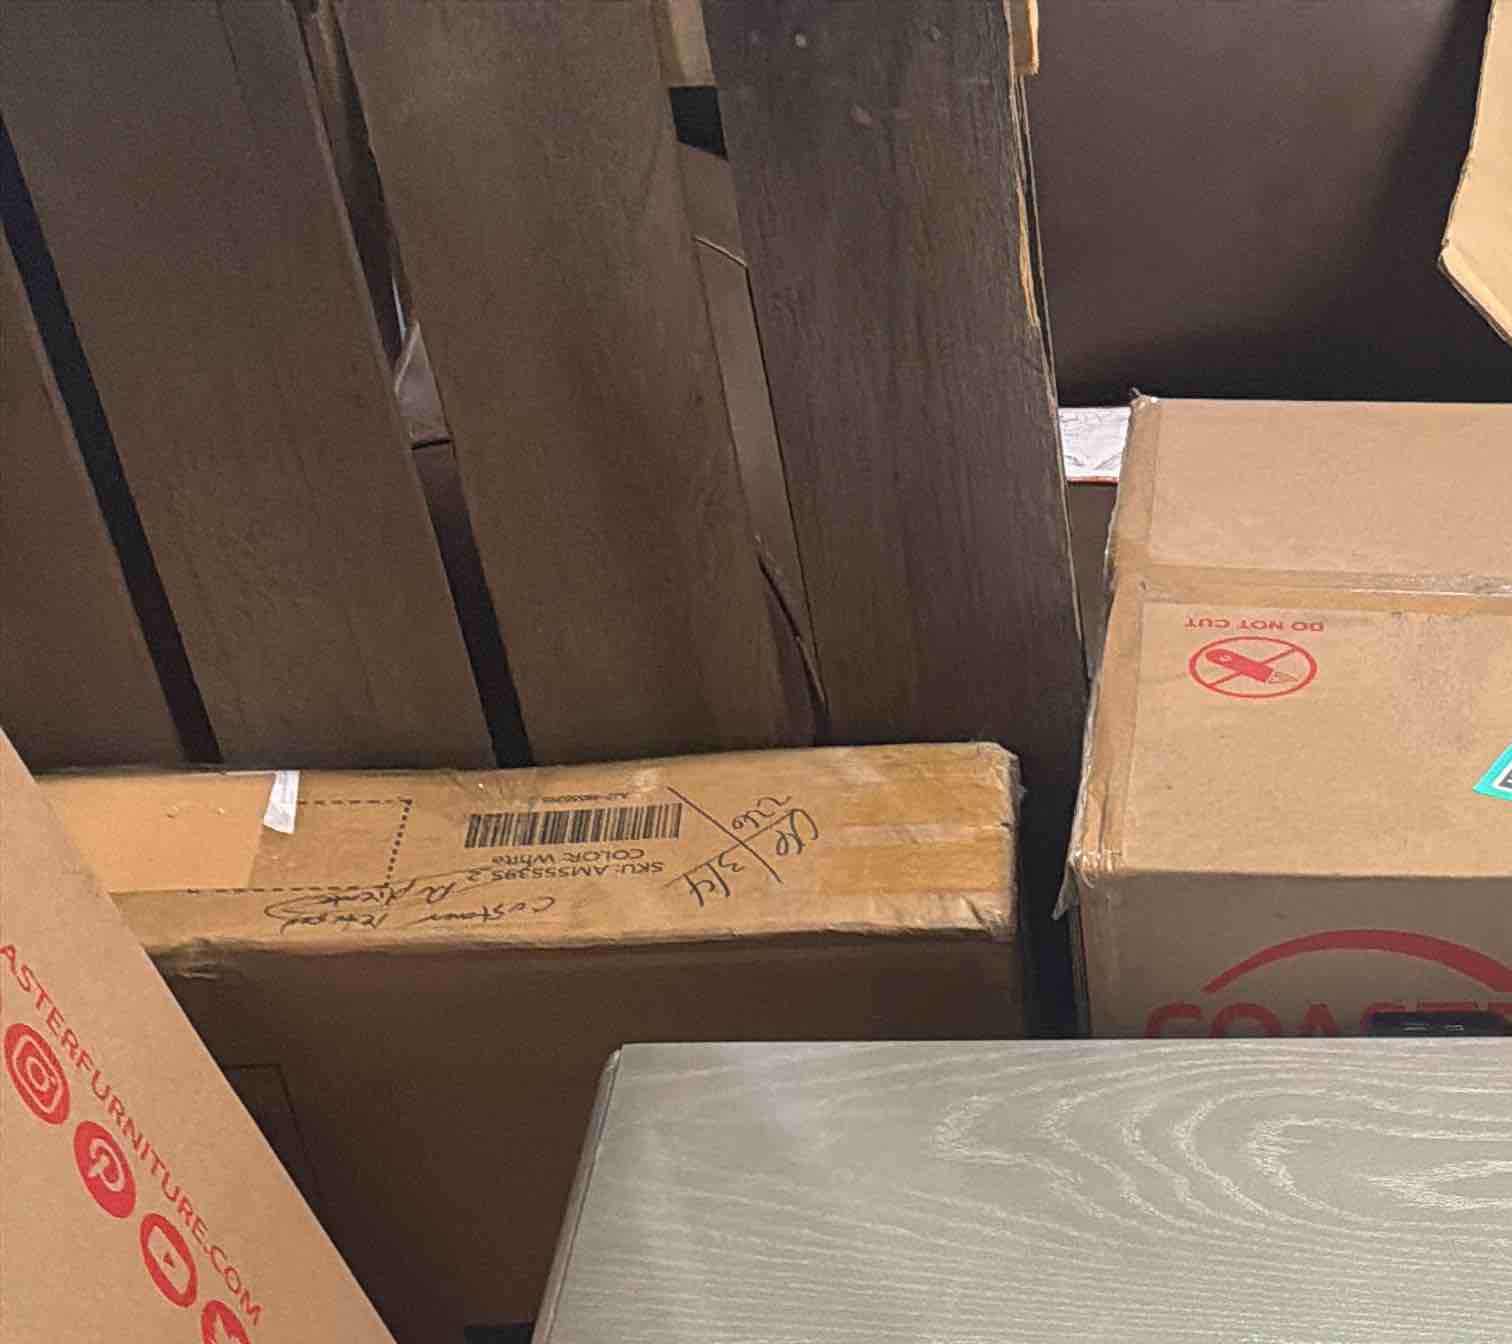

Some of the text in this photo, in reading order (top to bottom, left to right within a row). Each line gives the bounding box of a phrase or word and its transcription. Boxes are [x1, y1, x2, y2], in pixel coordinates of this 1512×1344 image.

[1184, 616, 1324, 632] DO NOT CUT
[491, 851, 555, 866] White
[616, 861, 665, 874] SKU:
